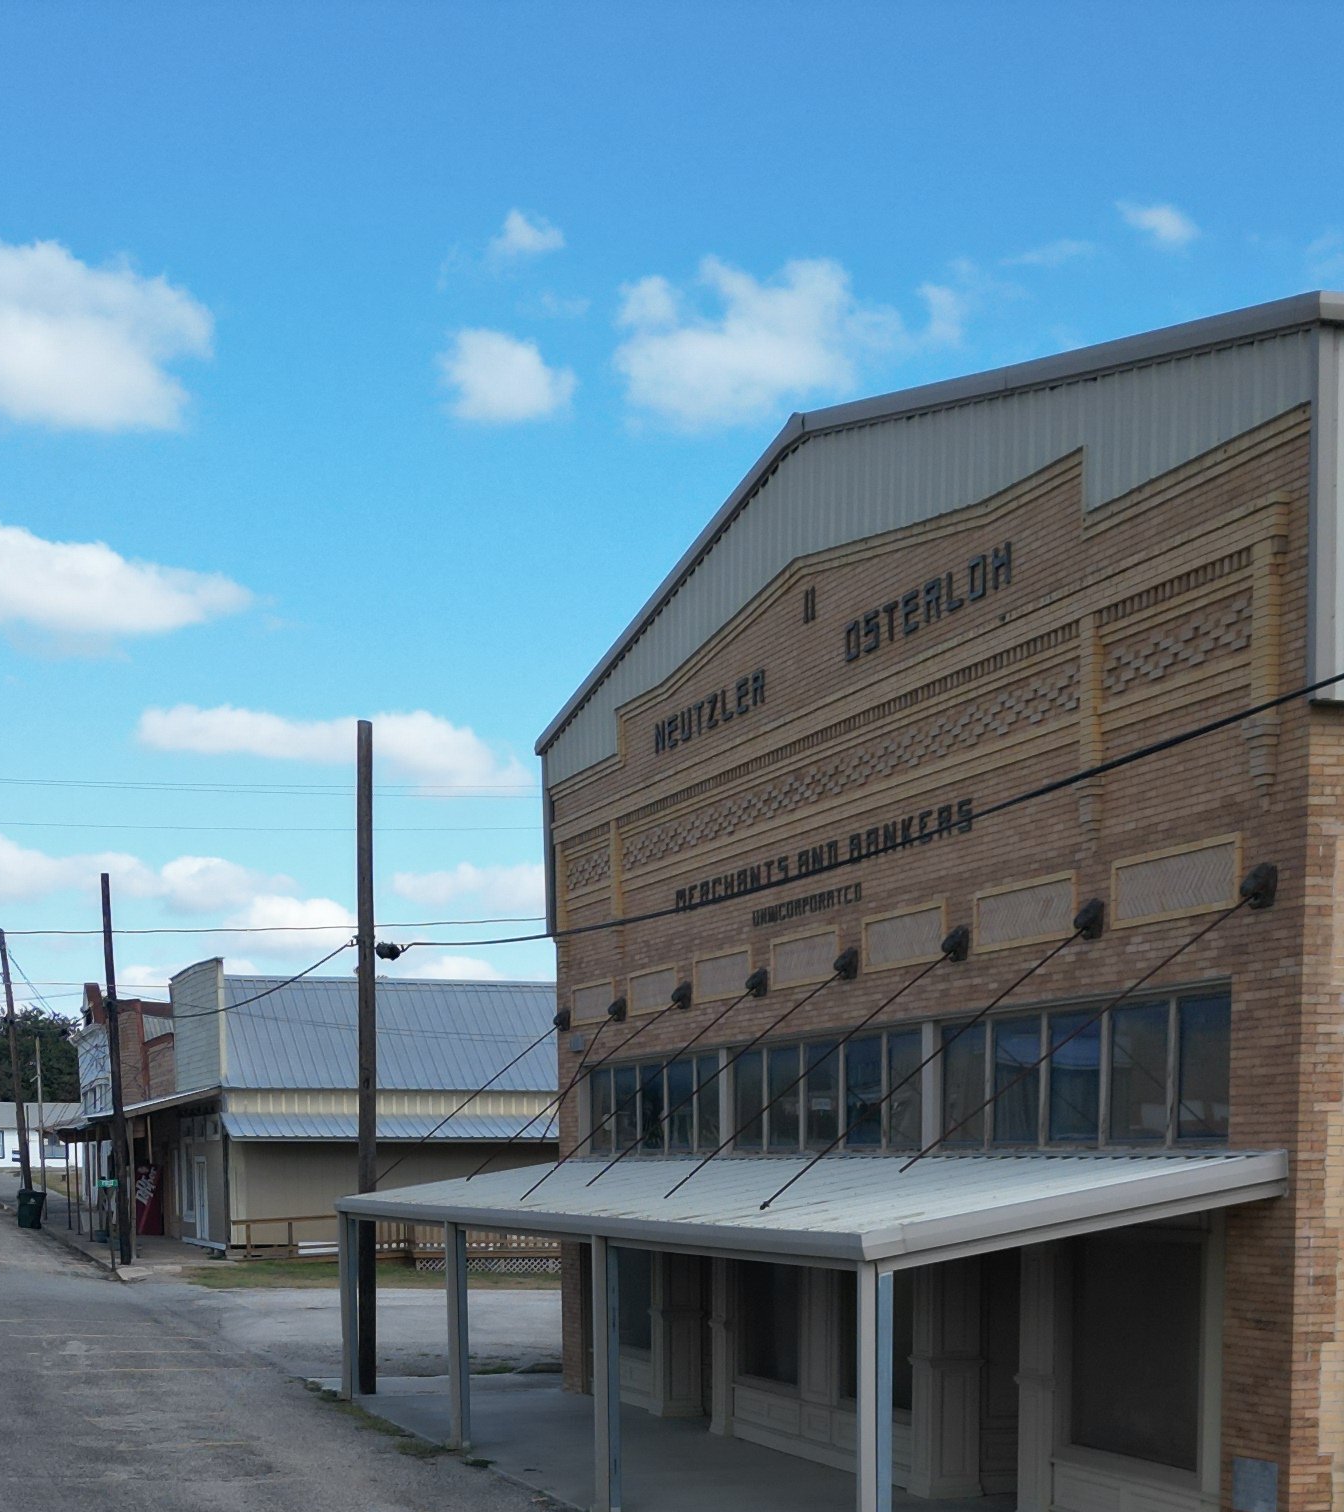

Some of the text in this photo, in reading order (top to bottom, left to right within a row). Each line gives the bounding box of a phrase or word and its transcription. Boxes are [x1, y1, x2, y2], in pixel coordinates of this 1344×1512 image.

[845, 541, 1012, 662] OSTERLOH
[655, 668, 765, 754] NEUTZLER
[675, 798, 973, 912] MERCHANTS AND BANKERS
